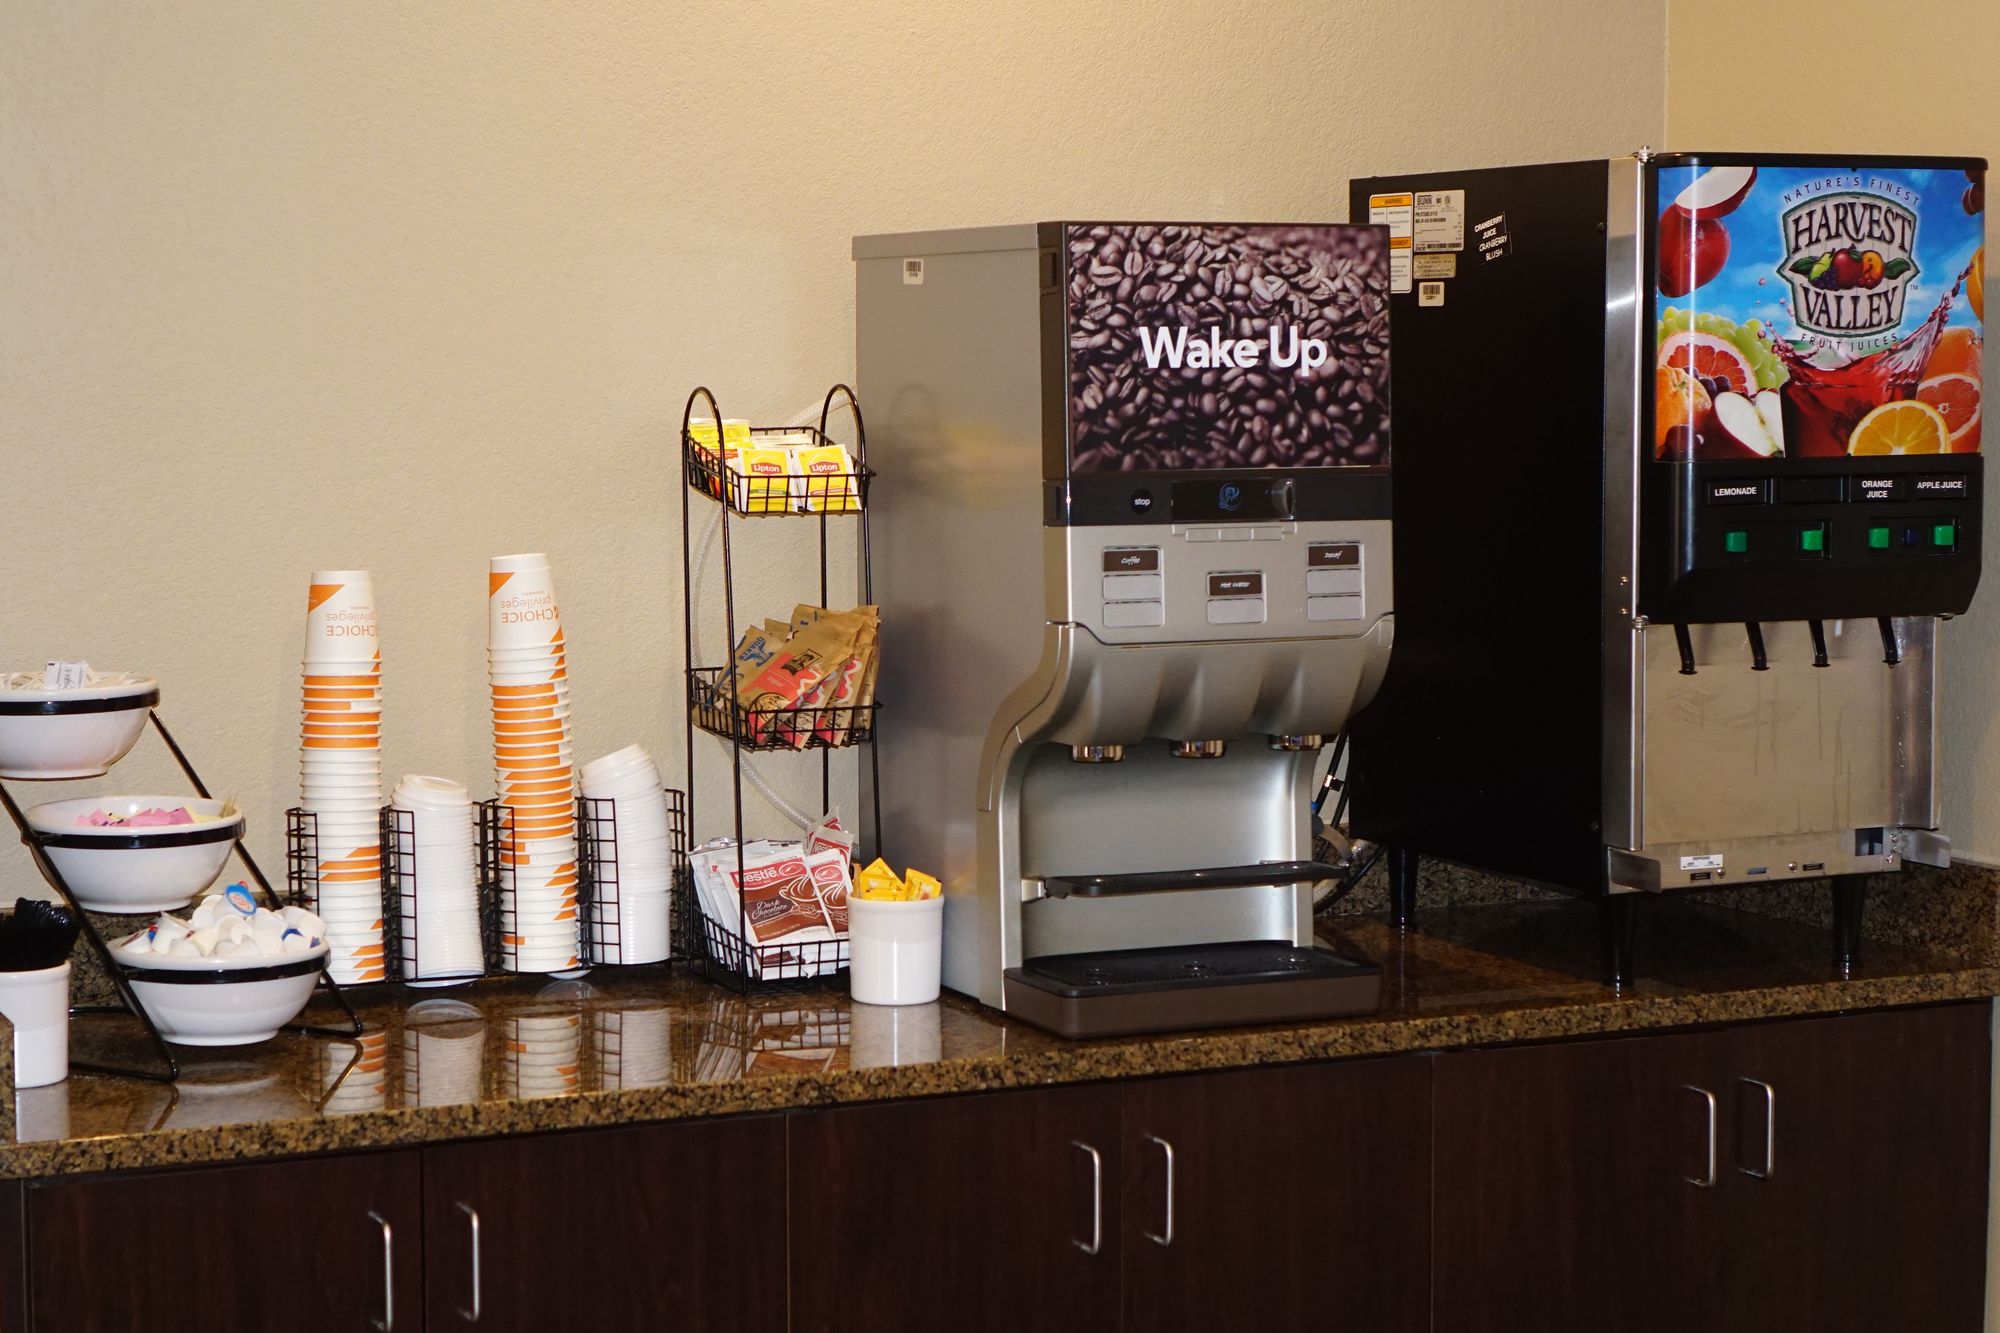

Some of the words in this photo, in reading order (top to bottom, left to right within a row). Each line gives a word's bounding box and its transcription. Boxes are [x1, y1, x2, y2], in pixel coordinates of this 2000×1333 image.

[1784, 177, 1860, 203] NATURE'S
[1870, 179, 1919, 205] FINEST
[1474, 215, 1504, 232] CRANBERRY
[1791, 202, 1912, 254] HARVEST
[1482, 228, 1497, 239] JUICE
[1478, 235, 1508, 252] CRANBERRY
[1485, 249, 1503, 261] BLUSH
[1800, 284, 1899, 330] VALLEY
[1801, 333, 1841, 350] FRUIT
[1851, 333, 1897, 352] JUICES
[1139, 325, 1260, 370] Wake
[1268, 325, 1328, 377] Up
[753, 464, 780, 473] Lipton
[811, 463, 838, 472] Lipton
[1861, 480, 1893, 488] ORANGE
[1916, 481, 1940, 489] APPLE
[1940, 480, 1963, 489] JUICE
[1714, 486, 1757, 497] LEMONADE
[1866, 490, 1888, 498] JUICE
[1134, 497, 1150, 507] stop
[501, 596, 552, 610] privileges
[501, 608, 555, 623] CHOICE
